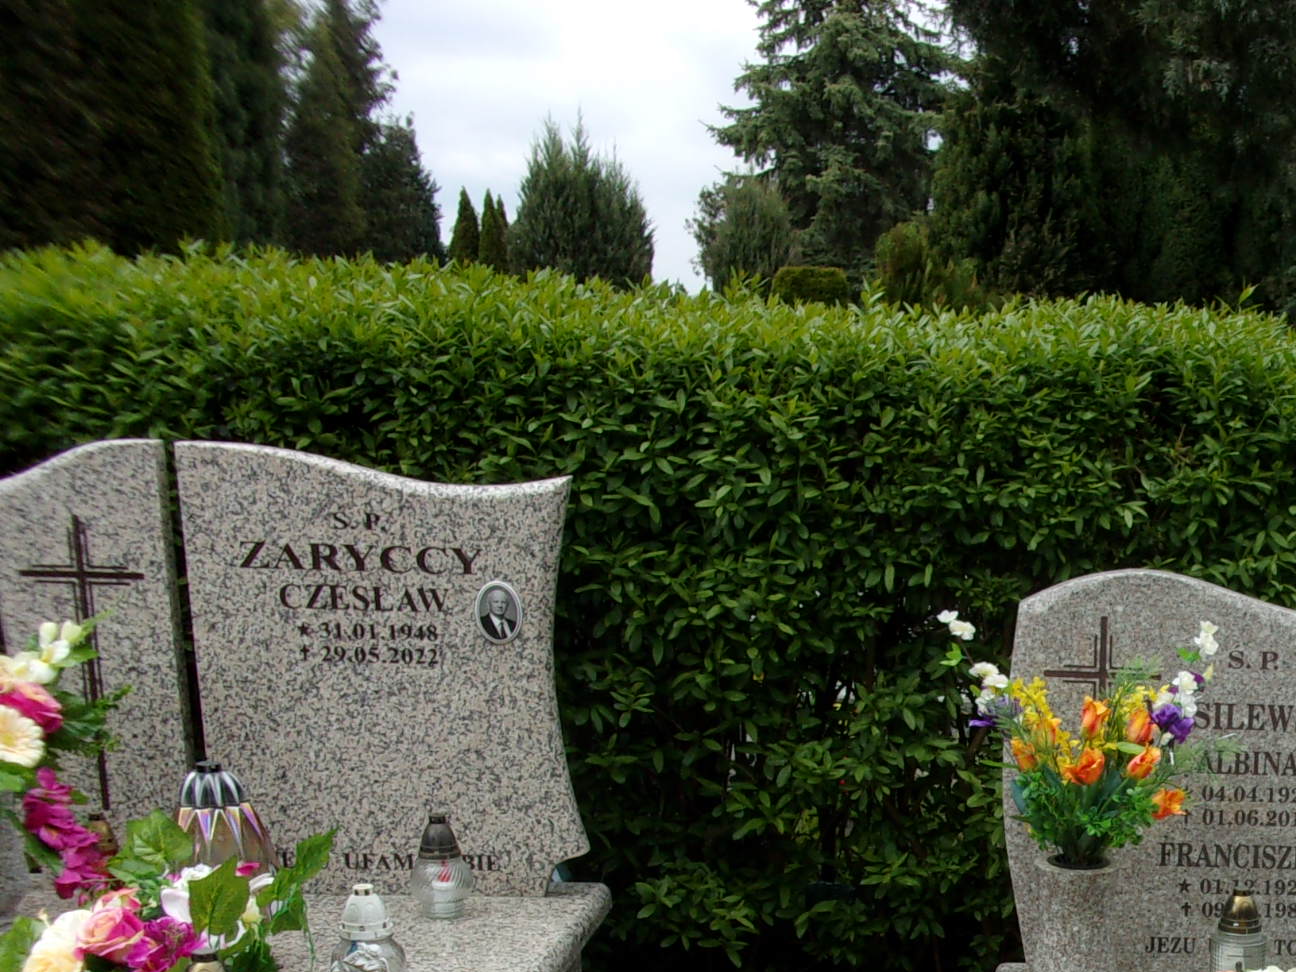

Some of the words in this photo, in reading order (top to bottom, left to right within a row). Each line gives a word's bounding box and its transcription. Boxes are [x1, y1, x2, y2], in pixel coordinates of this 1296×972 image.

[240, 540, 482, 575] ZARYCCY
[1260, 651, 1279, 670] P.
[345, 852, 415, 871] UFAM
[1145, 936, 1196, 954] JEZU
